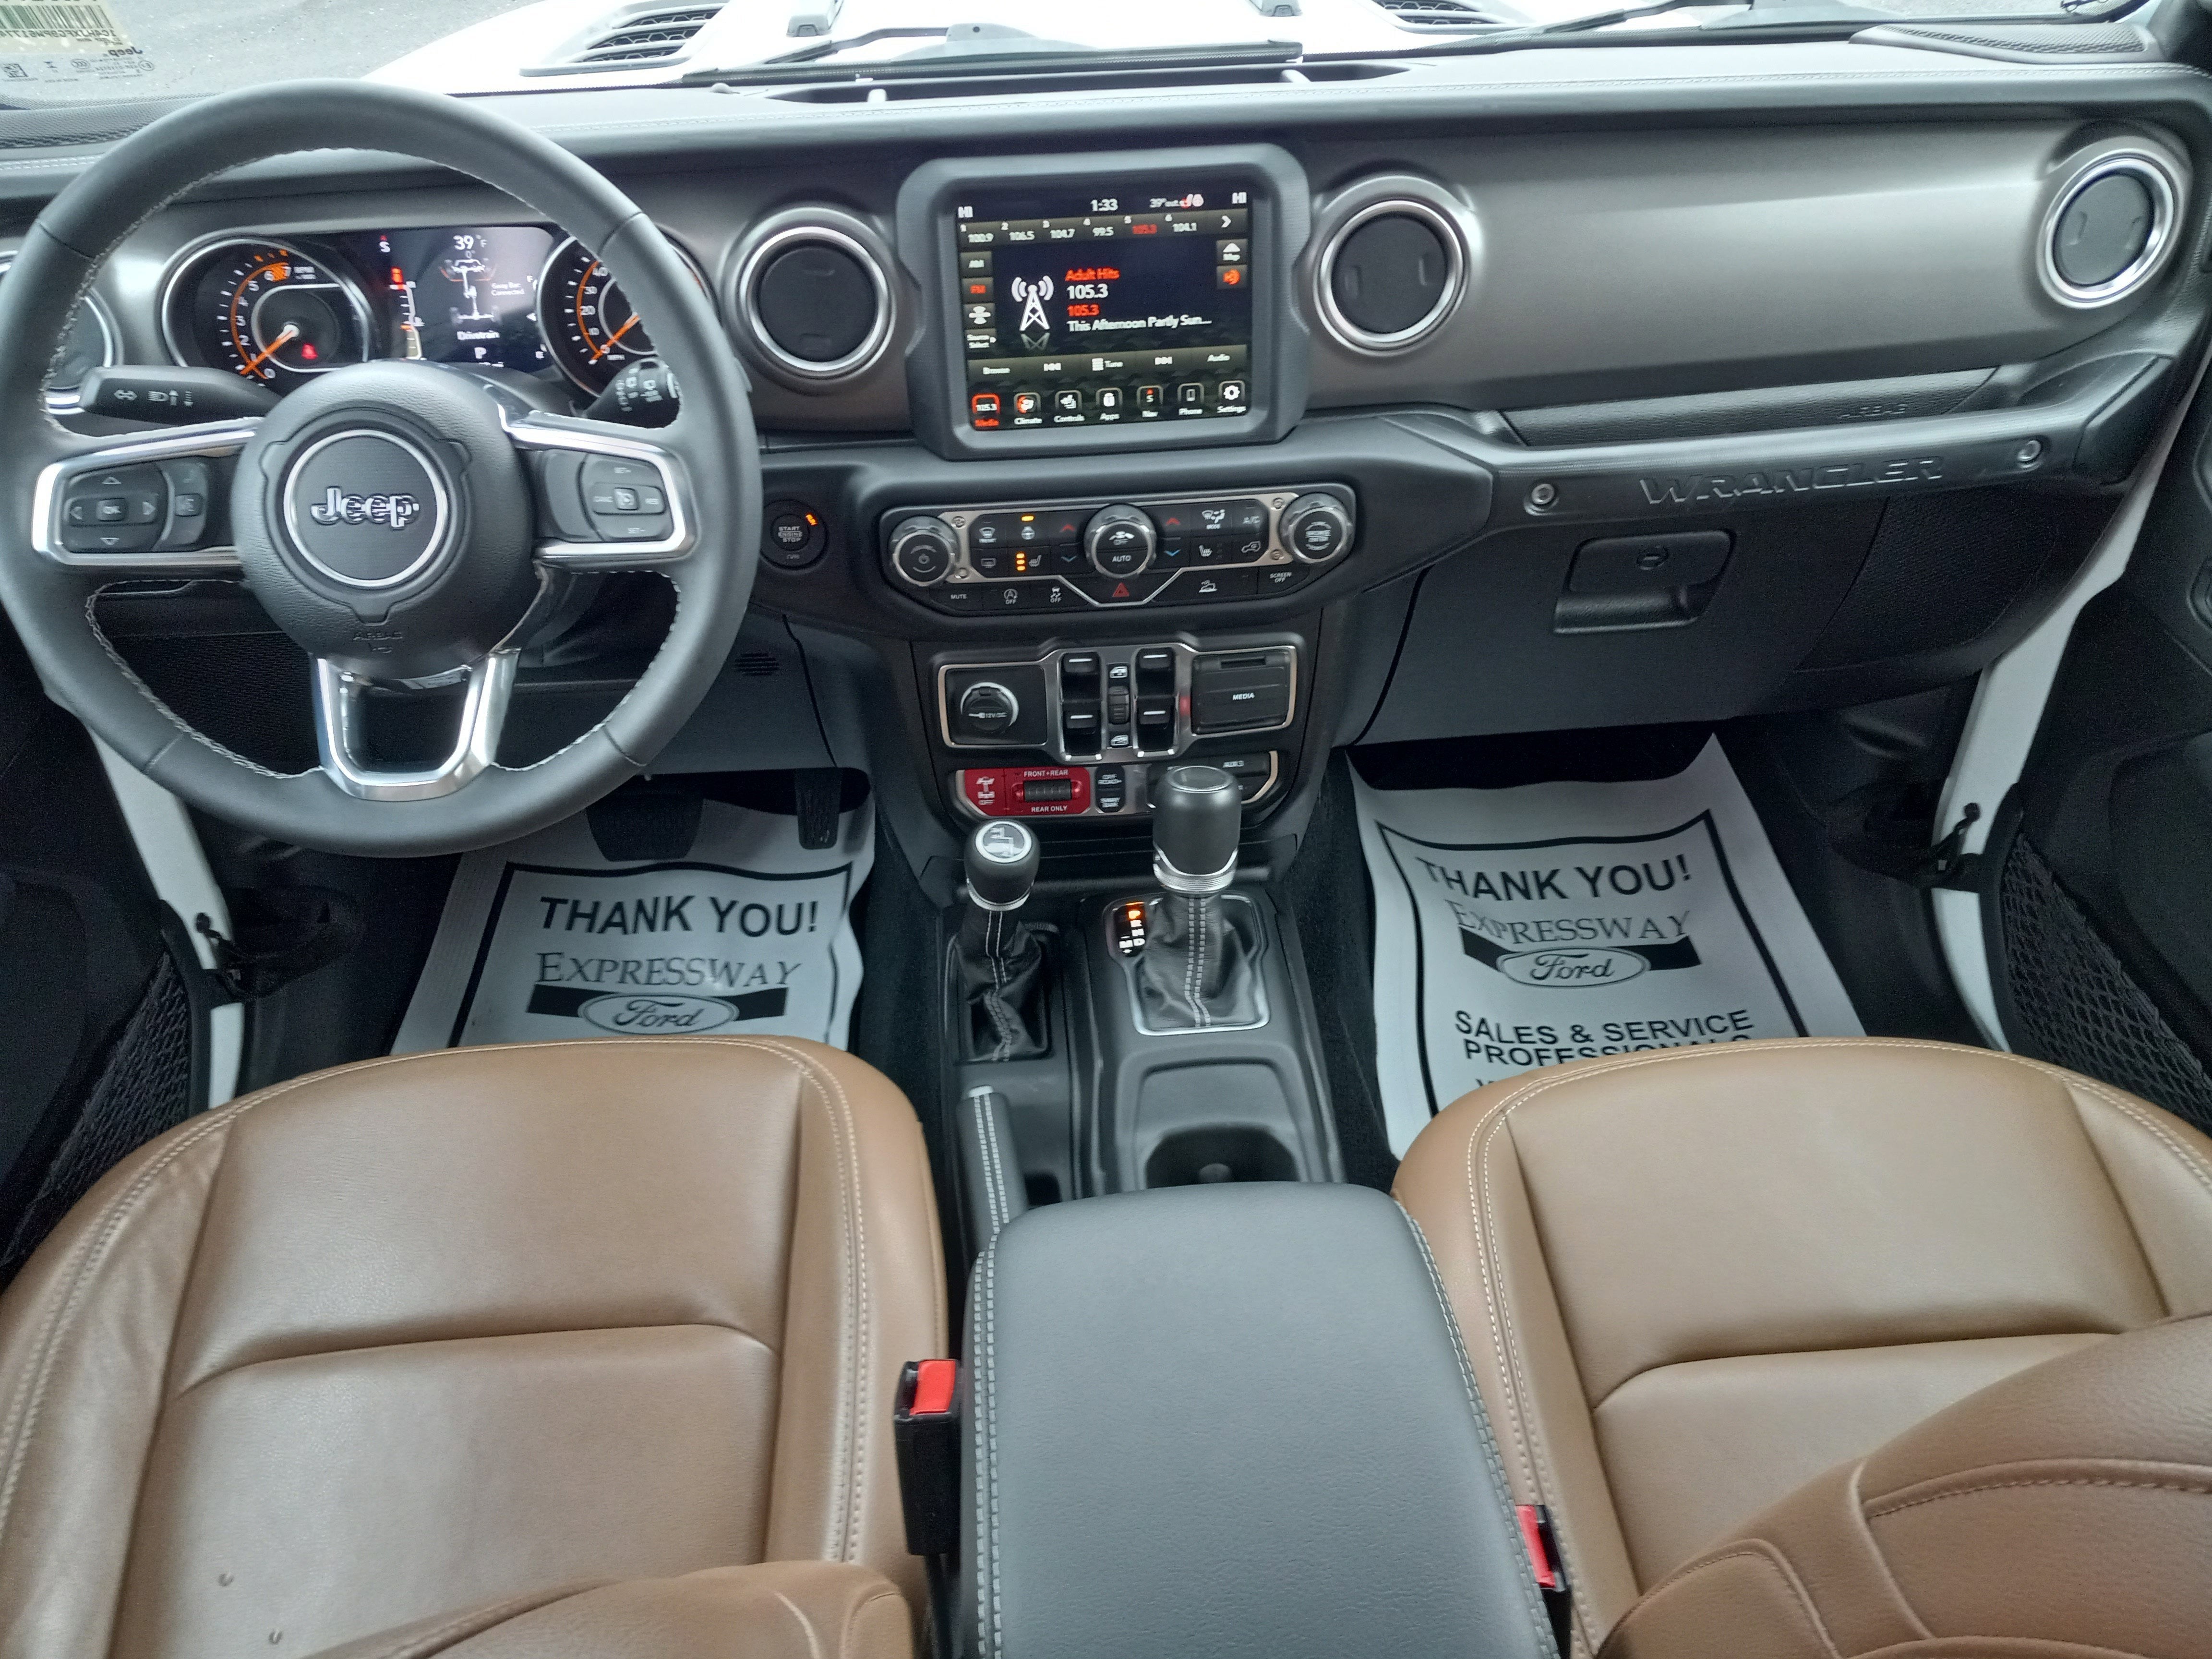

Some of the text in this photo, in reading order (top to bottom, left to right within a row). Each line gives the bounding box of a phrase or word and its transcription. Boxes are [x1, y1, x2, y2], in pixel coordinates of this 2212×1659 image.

[1091, 198, 1118, 211] 1:33
[1001, 221, 1009, 230] 2
[1043, 219, 1049, 228] 3
[380, 241, 390, 252] S
[453, 235, 474, 250] 39
[1066, 284, 1108, 299] 105.3
[1067, 304, 1100, 317] 105.3
[1067, 321, 1091, 332] This
[474, 347, 487, 359] P
[1639, 456, 1944, 504] WRANGLER
[311, 486, 420, 530] Jeep
[1232, 692, 1255, 700] MEDIA
[1415, 854, 1694, 902] THANK YOU!
[540, 895, 818, 938] THANK YOU!
[1444, 899, 1691, 944] EXPRESSWAY
[535, 952, 802, 991] EXPRESSWAY
[1529, 952, 1616, 981] Ford
[613, 998, 704, 1029] Ford
[1455, 1009, 1755, 1045] SALES & SERVICE
